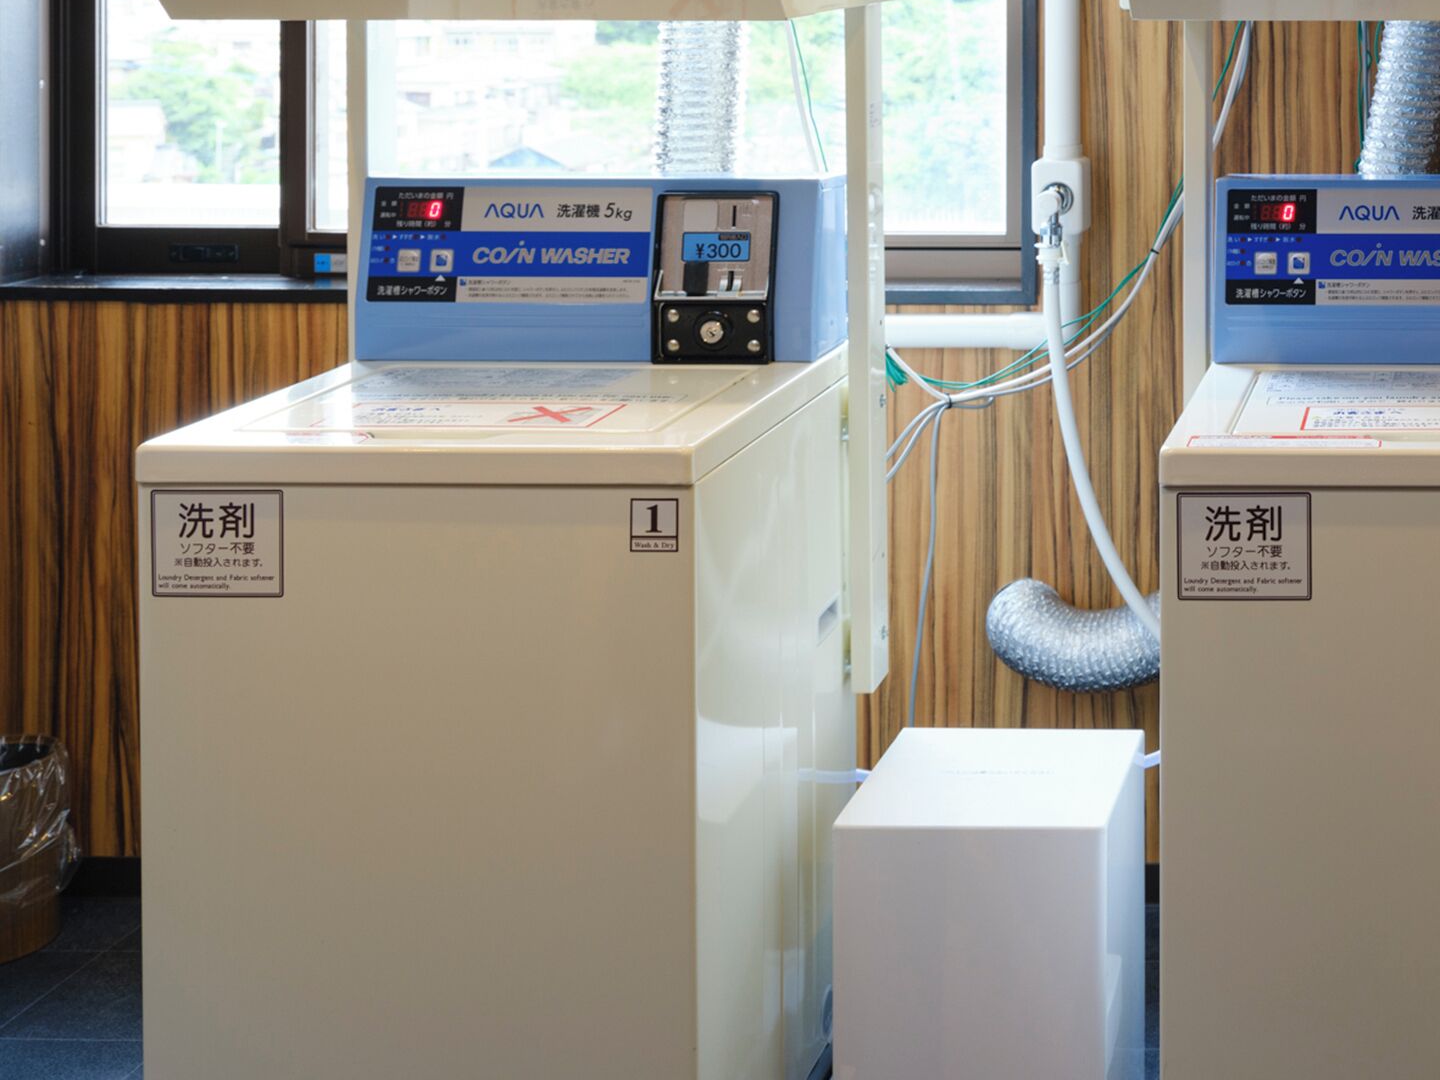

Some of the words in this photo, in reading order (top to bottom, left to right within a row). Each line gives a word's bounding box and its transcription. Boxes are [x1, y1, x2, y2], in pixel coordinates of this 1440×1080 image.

[429, 202, 441, 218] 0
[484, 203, 545, 218] AQUA
[557, 204, 600, 218] 洗濯機
[604, 202, 632, 221] 5kg
[1283, 204, 1294, 221] 0
[1339, 205, 1400, 221] AQUA
[541, 247, 631, 264] WASHER
[696, 243, 742, 259] ¥300
[178, 502, 255, 539] 洗剤
[645, 504, 663, 533] 1
[1205, 505, 1282, 542] 洗剤
[180, 542, 255, 555] ソフター不要
[1207, 545, 1283, 558] ソフター不要
[174, 557, 263, 568] ※自動投入されます。
[1200, 560, 1291, 571] ※自動投入されます。
